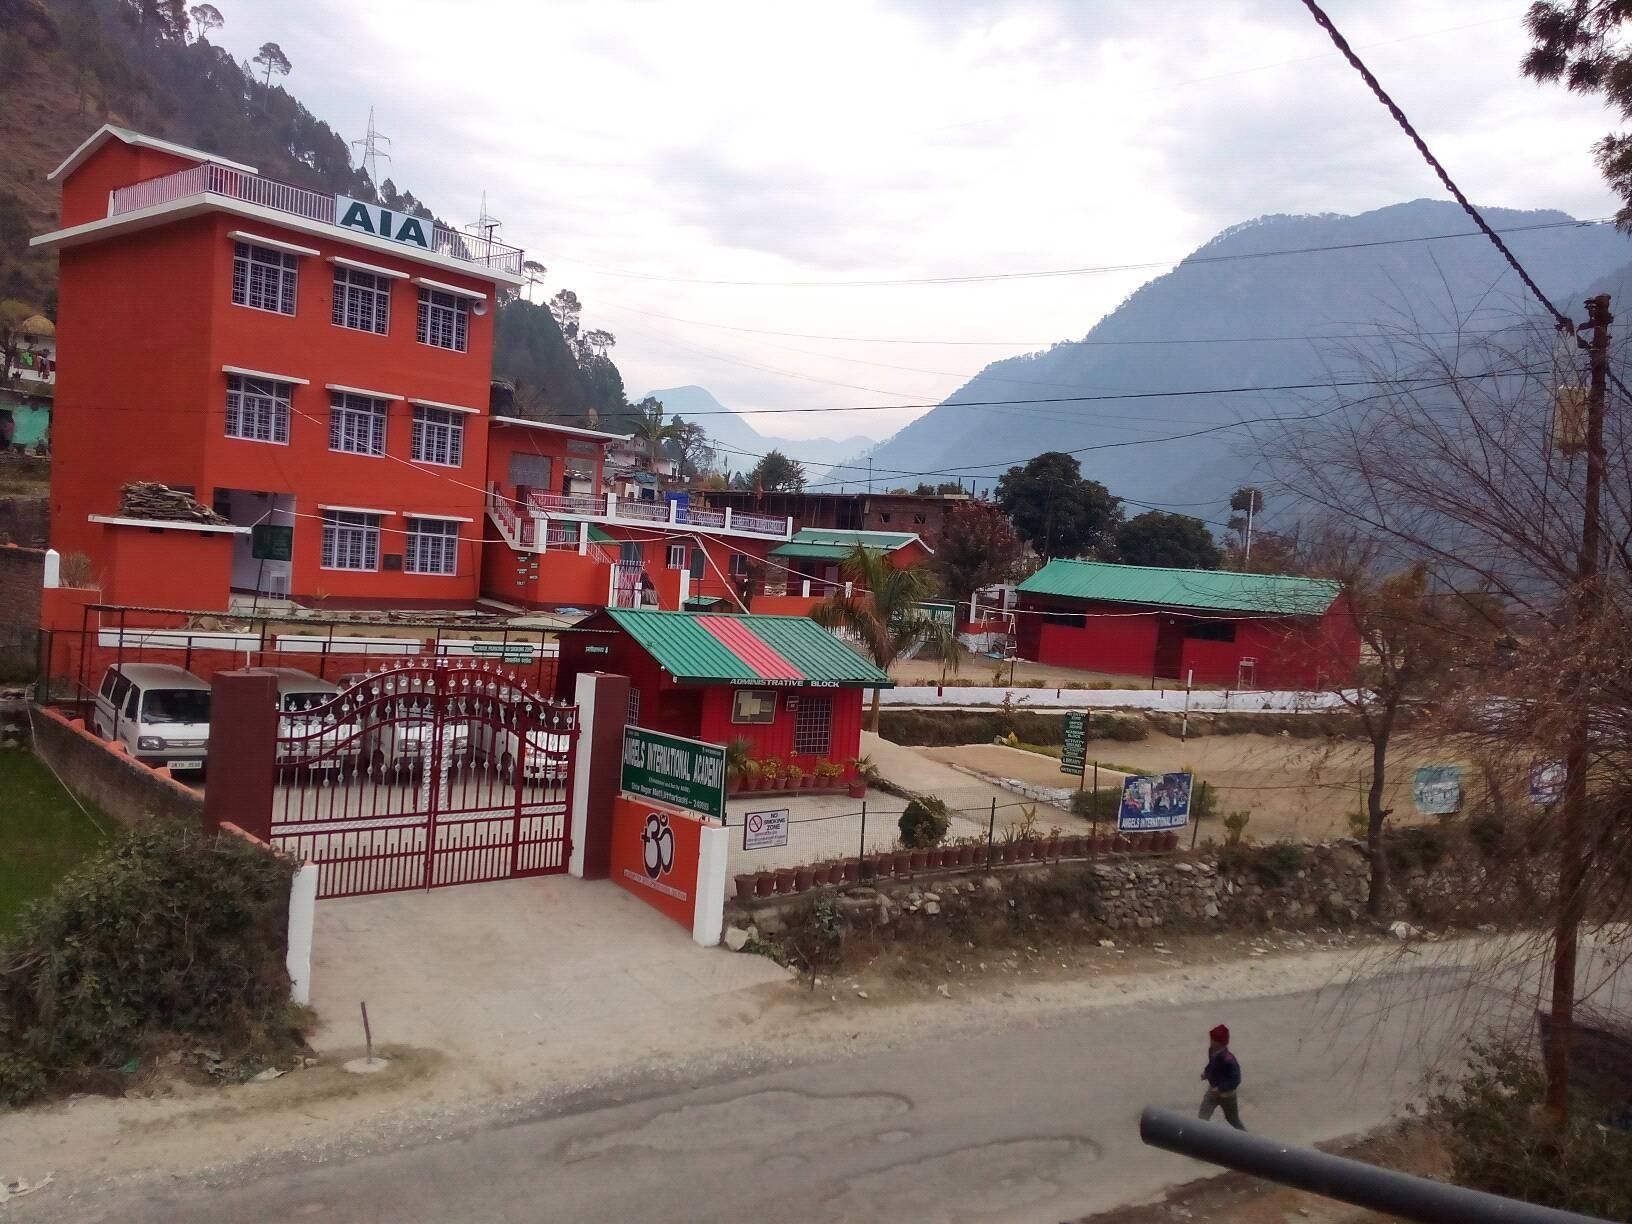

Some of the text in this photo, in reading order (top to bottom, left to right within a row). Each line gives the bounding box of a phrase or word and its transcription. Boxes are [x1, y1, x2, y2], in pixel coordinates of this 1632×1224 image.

[340, 201, 428, 248] AIA
[729, 677, 840, 688] ADMINISTRATIVE BLOCK
[624, 737, 646, 768] ANGELS
[646, 742, 691, 781] INTERNATIONAL
[692, 753, 723, 789] ACADEMY
[763, 817, 786, 825] SMOKING
[1121, 817, 1139, 828] ANGELS
[1140, 816, 1171, 828] INTERNATIONAL
